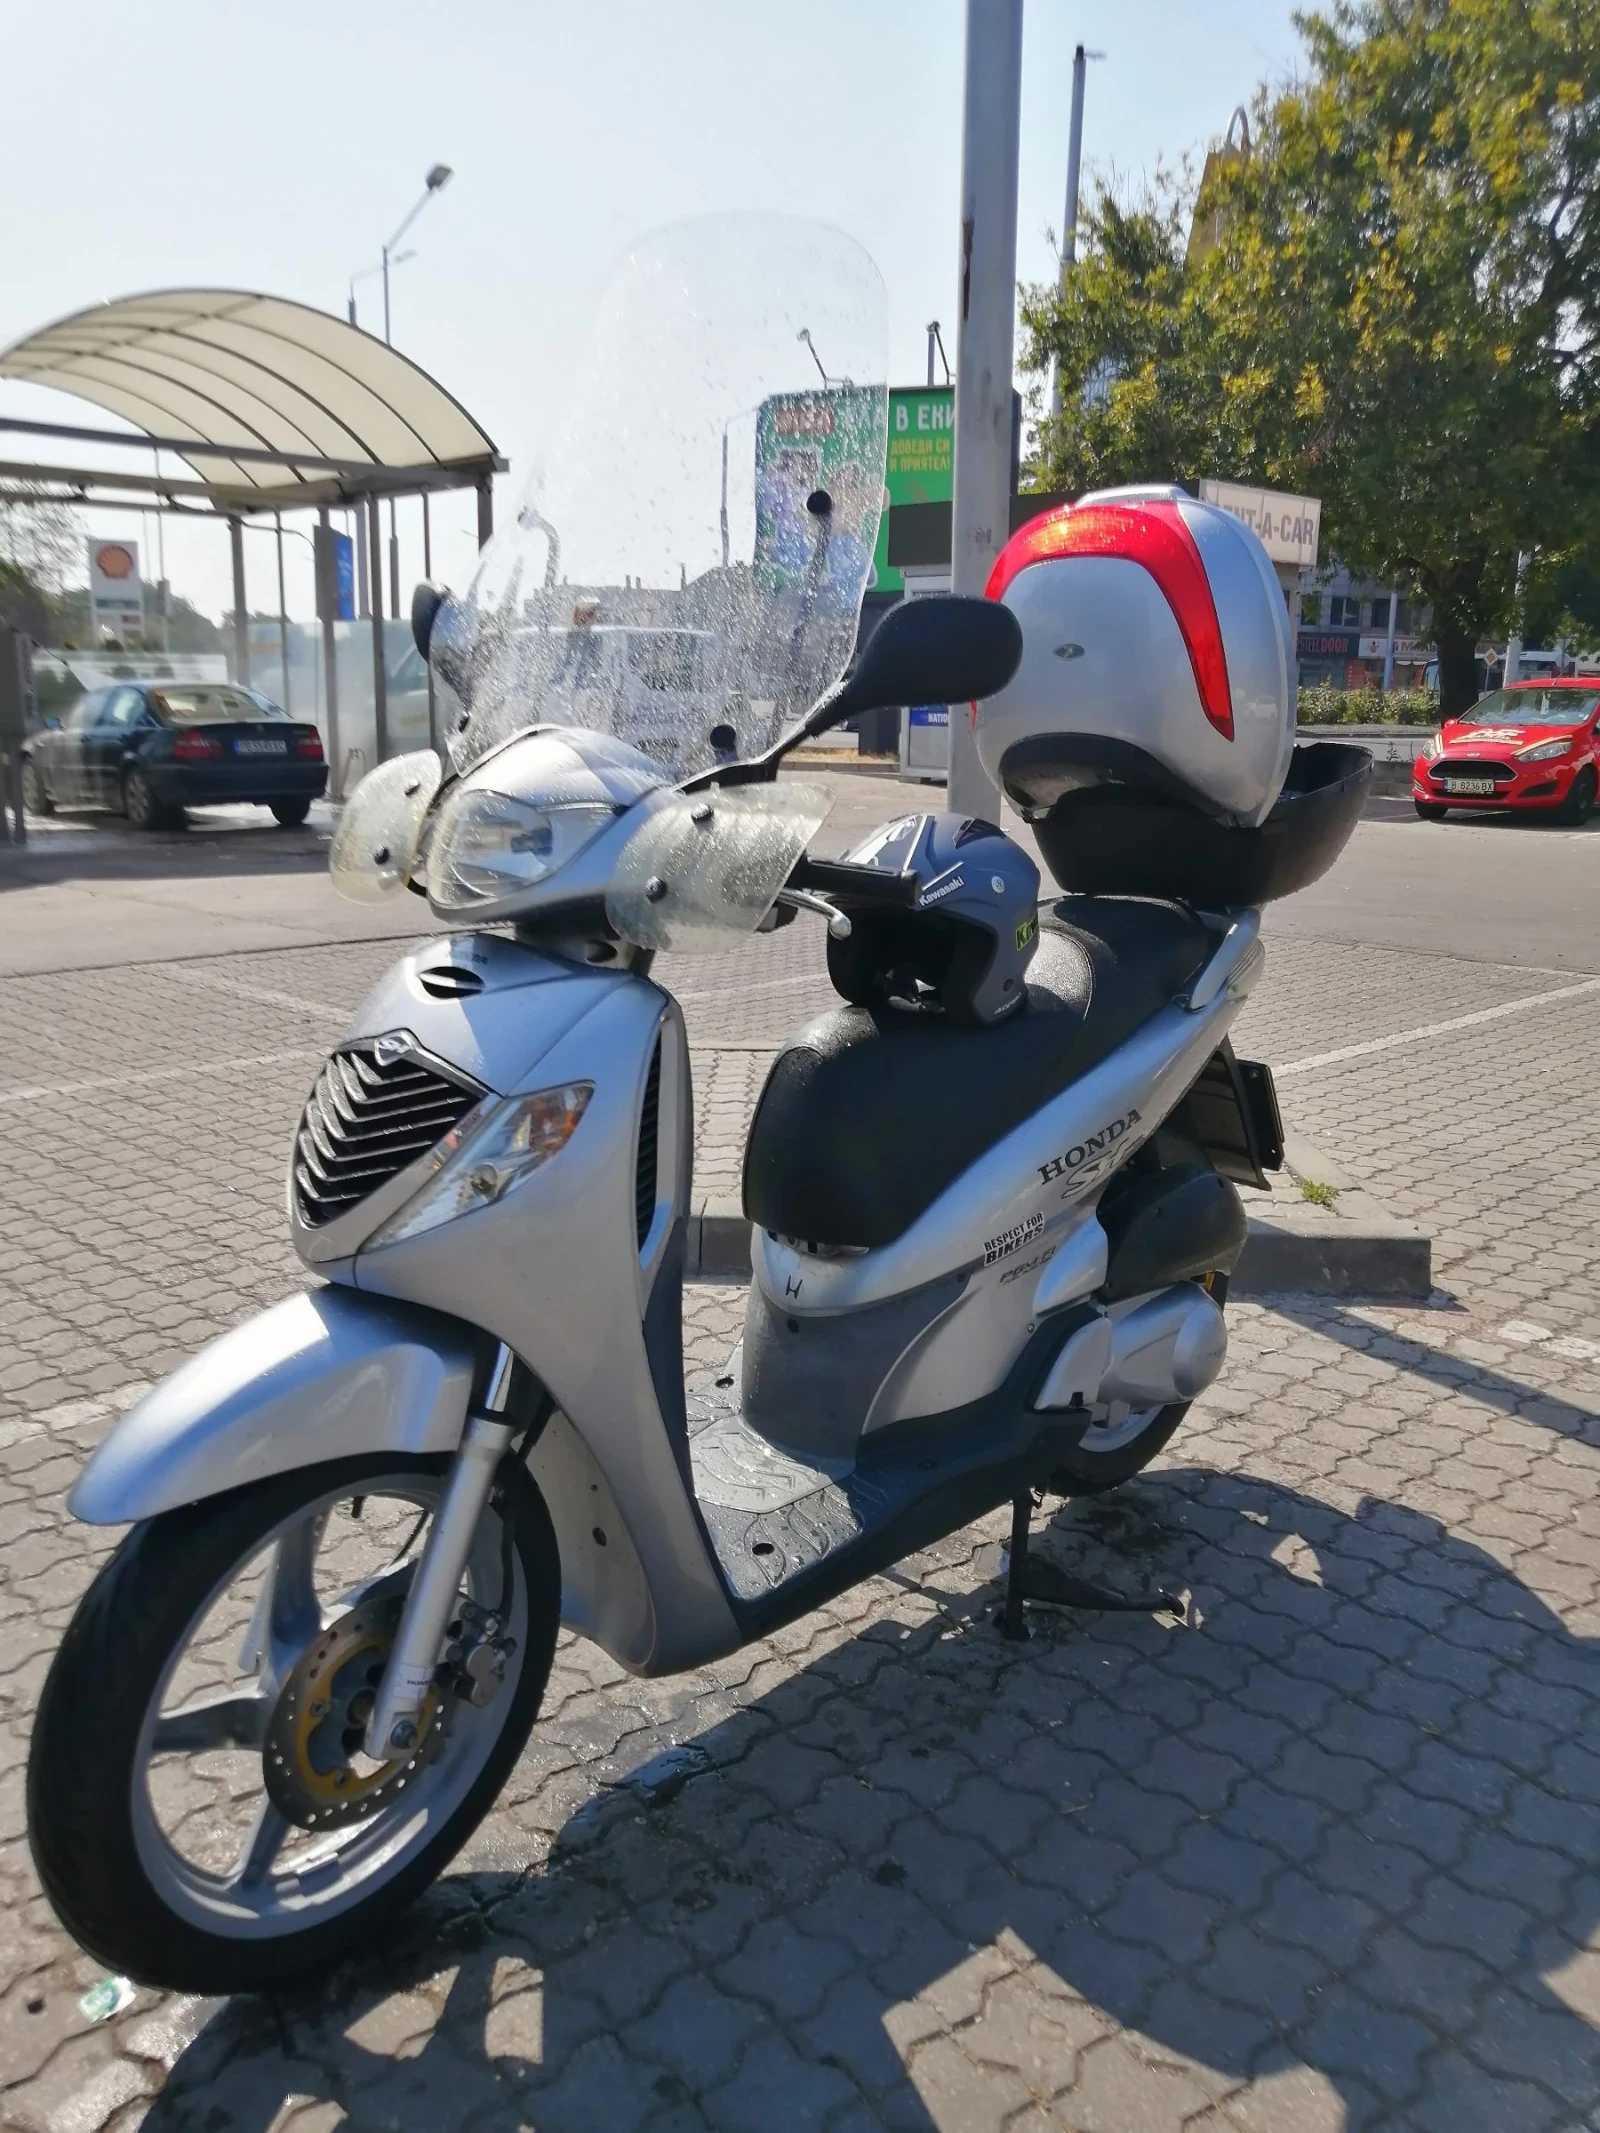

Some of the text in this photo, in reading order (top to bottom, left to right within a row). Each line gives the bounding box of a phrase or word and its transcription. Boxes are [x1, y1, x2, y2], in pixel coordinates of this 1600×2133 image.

[896, 404, 909, 431] В
[890, 438, 950, 456] ДОВЕДИ СИ
[889, 456, 897, 472] И
[1460, 781, 1480, 791] 8236
[1481, 782, 1493, 791] BX
[919, 876, 965, 907] Kawasaki
[1037, 1109, 1142, 1185] HONDA
[984, 1212, 1044, 1252] RESPECT FOR
[985, 1224, 1044, 1264] BIKERS
